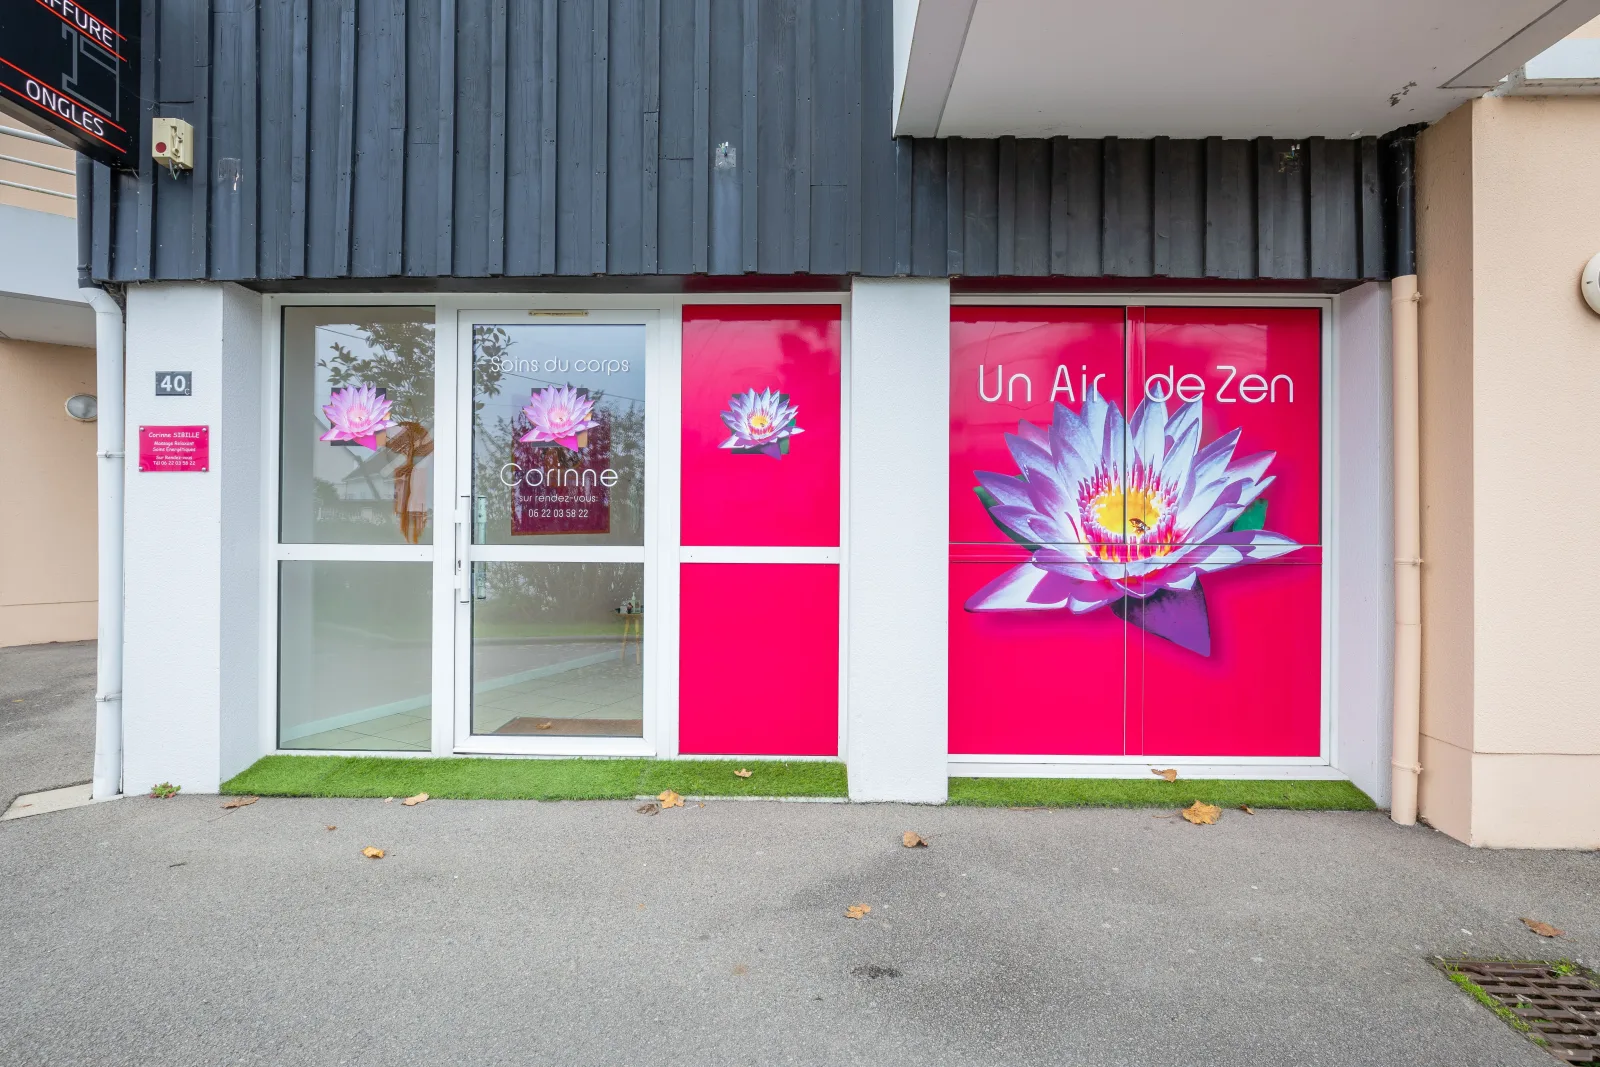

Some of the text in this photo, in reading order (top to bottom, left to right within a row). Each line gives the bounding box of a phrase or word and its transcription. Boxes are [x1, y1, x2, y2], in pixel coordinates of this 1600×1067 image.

[44, 0, 113, 48] FURE
[26, 79, 104, 136] ONGLES
[490, 356, 630, 376] Soins du corps
[978, 364, 1295, 403] Un Air de Zen
[500, 462, 619, 487] Corinne
[519, 495, 533, 503] sur
[528, 509, 589, 518] 06 22 03 58 22
